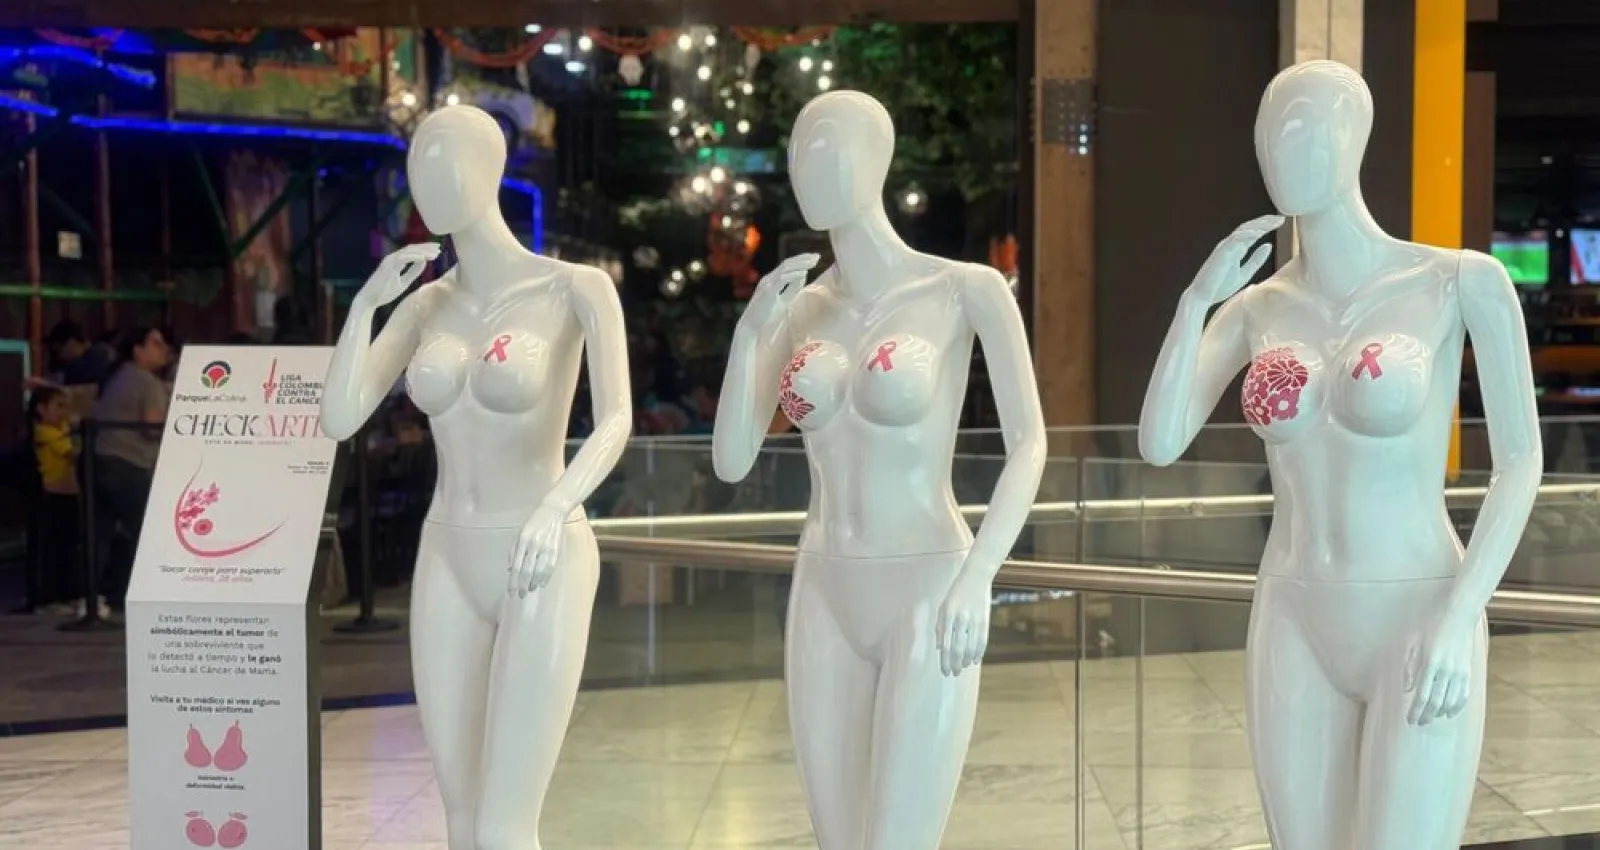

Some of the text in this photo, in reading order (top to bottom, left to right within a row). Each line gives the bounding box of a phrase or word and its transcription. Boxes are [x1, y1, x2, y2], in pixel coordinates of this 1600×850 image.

[281, 374, 301, 382] LIGA
[158, 614, 269, 626] Estas flores representan
[150, 626, 278, 637] simbólicamente el tumor de
[164, 640, 264, 652] una sobreviviente que
[159, 651, 194, 661] detectó
[205, 653, 237, 663] tiempo
[240, 655, 246, 664] y
[248, 653, 256, 662] le
[259, 654, 281, 664] ganó
[151, 665, 159, 673] la
[161, 665, 187, 674] lucha
[189, 665, 197, 674] al
[200, 665, 232, 674] Cáncer
[235, 666, 246, 675] de
[150, 695, 173, 703] Visita
[183, 696, 192, 704] tu
[236, 698, 250, 706] ves
[190, 705, 212, 713] estos
